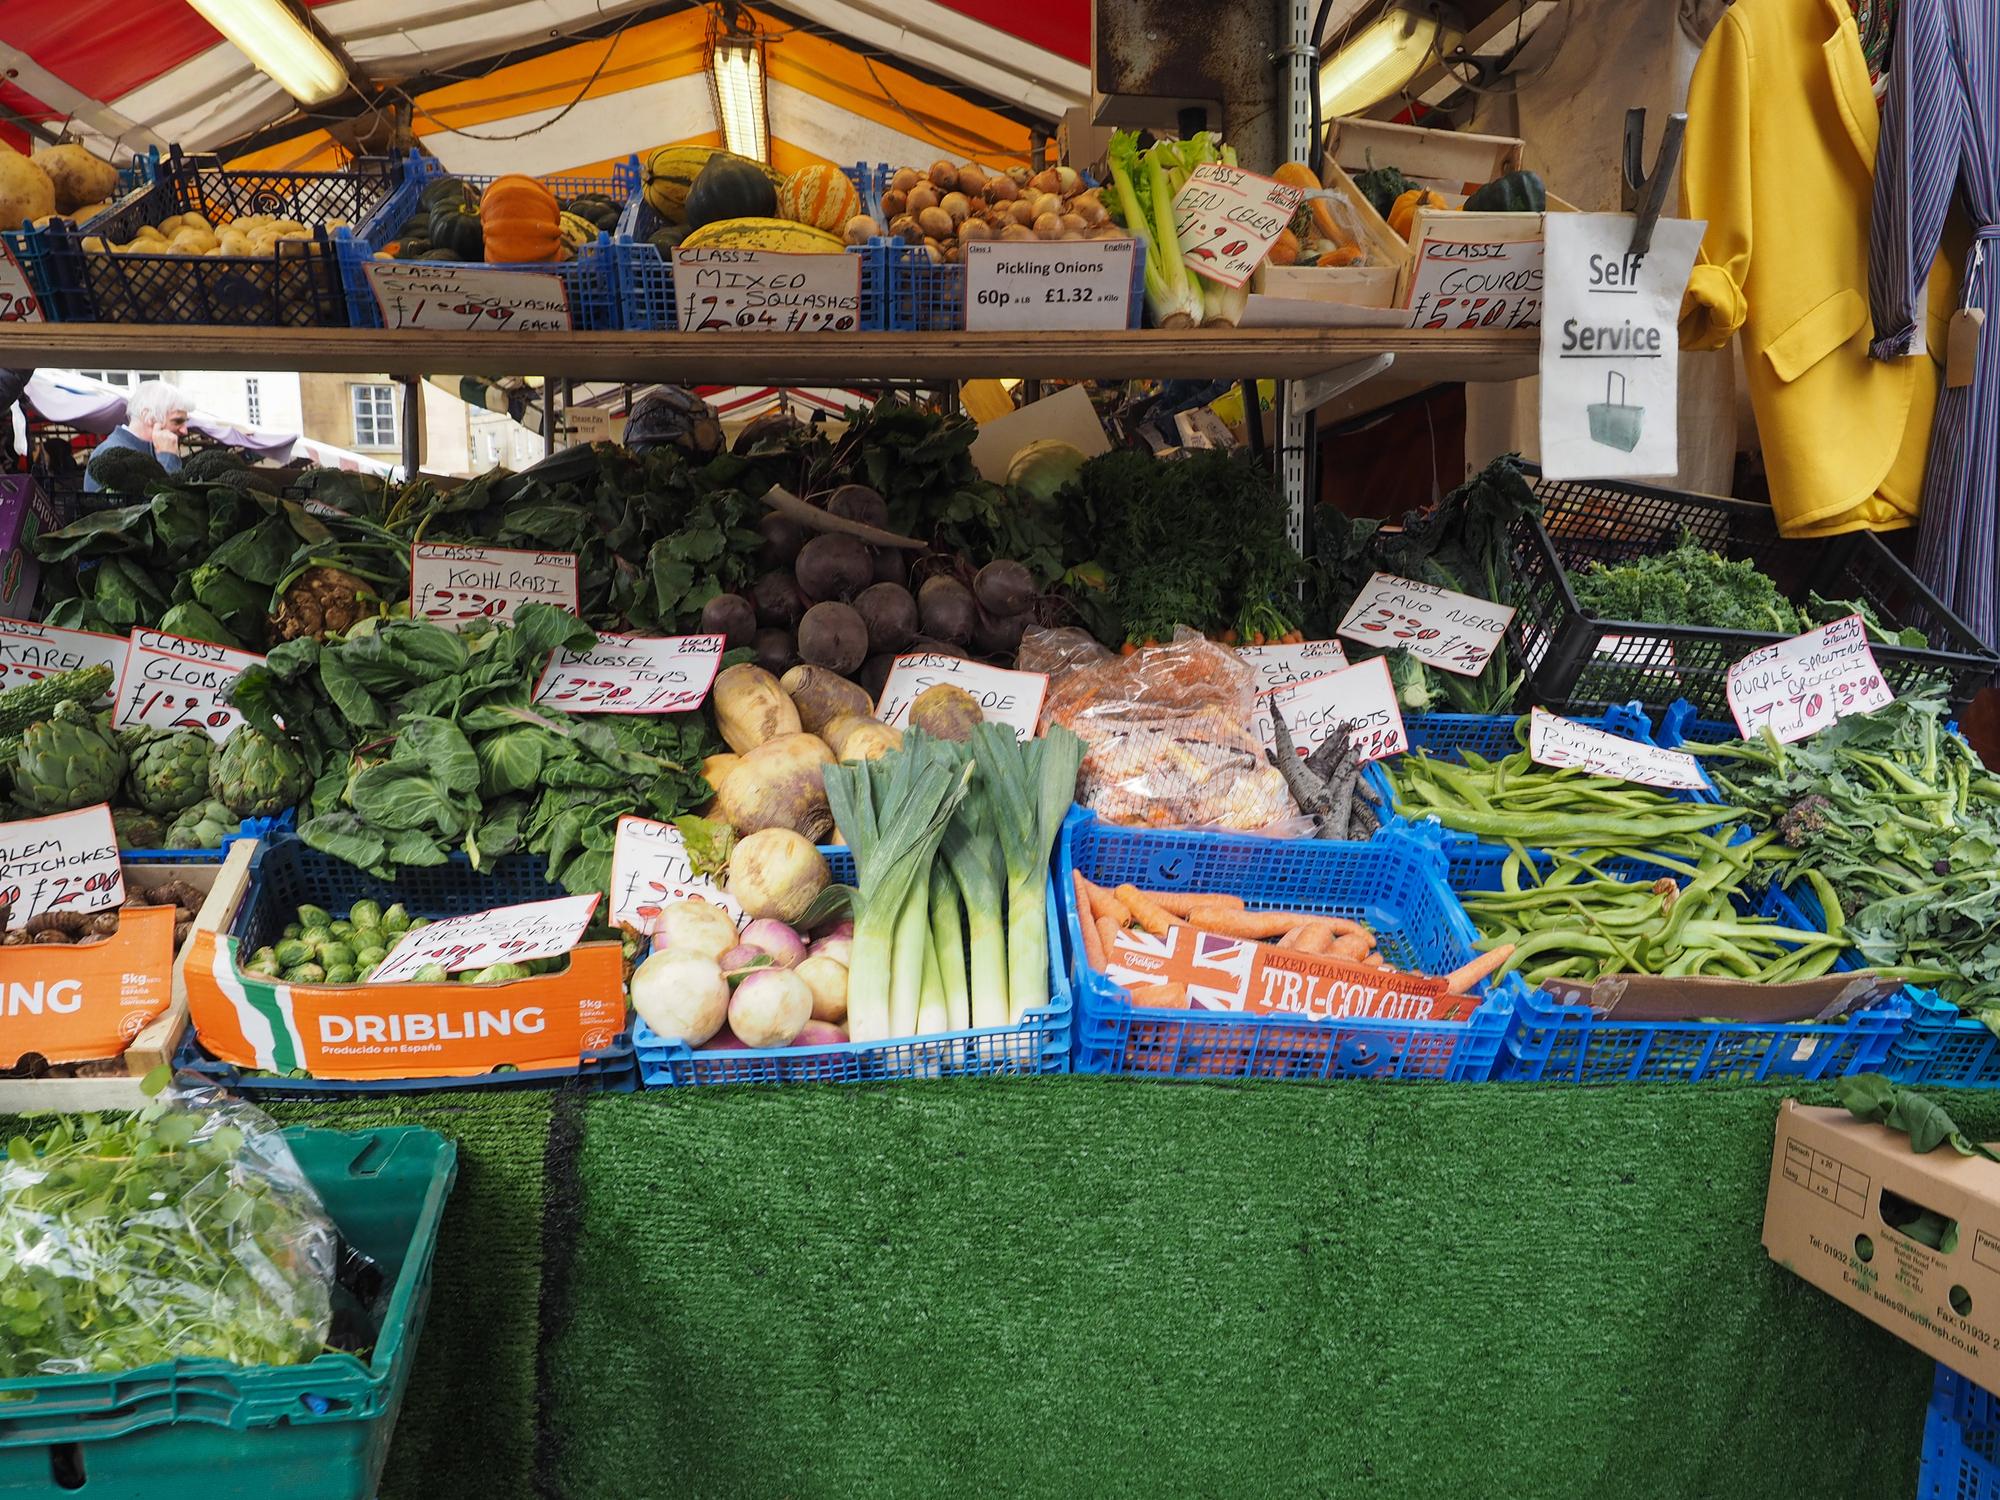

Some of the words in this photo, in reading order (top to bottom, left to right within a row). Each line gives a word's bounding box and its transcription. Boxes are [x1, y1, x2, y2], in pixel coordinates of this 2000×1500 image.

[1226, 205, 1284, 241] CELERY
[969, 246, 987, 254] Class
[1103, 243, 1132, 252] English
[695, 268, 807, 290] MIXED
[996, 261, 1051, 277] Pickling
[1054, 261, 1104, 274] Onions
[1439, 268, 1543, 296] GOURDS
[1588, 252, 1645, 286] Self
[383, 280, 464, 294] SMALL
[745, 290, 860, 310] SQUASHES
[976, 289, 1011, 308] 60p
[1044, 287, 1093, 304] £1.32
[1561, 317, 1662, 351] Service
[1445, 609, 1506, 633] NERO
[629, 669, 688, 684] TOPS
[1733, 664, 1793, 701] PURPLE
[1798, 640, 1868, 672] SPROUTING
[1257, 704, 1337, 744] BACK
[121, 972, 146, 986] 5kg
[1264, 953, 1308, 973] MIXED
[1308, 961, 1386, 989] CHANTENAY
[1258, 966, 1435, 1020] TRI-COLOUR
[318, 1007, 545, 1044] DRIBLING
[321, 1044, 381, 1056] Producido
[383, 1046, 398, 1054] en
[400, 1043, 442, 1054] España
[1808, 1234, 1823, 1249] Tel:
[1823, 1244, 1849, 1266] 01932
[1843, 1270, 1873, 1297] E-mail:
[1873, 1291, 1980, 1359] sales@herbfresh.co.uk
[1936, 1305, 1958, 1328] Fax:
[1959, 1317, 1991, 1347] 01932
